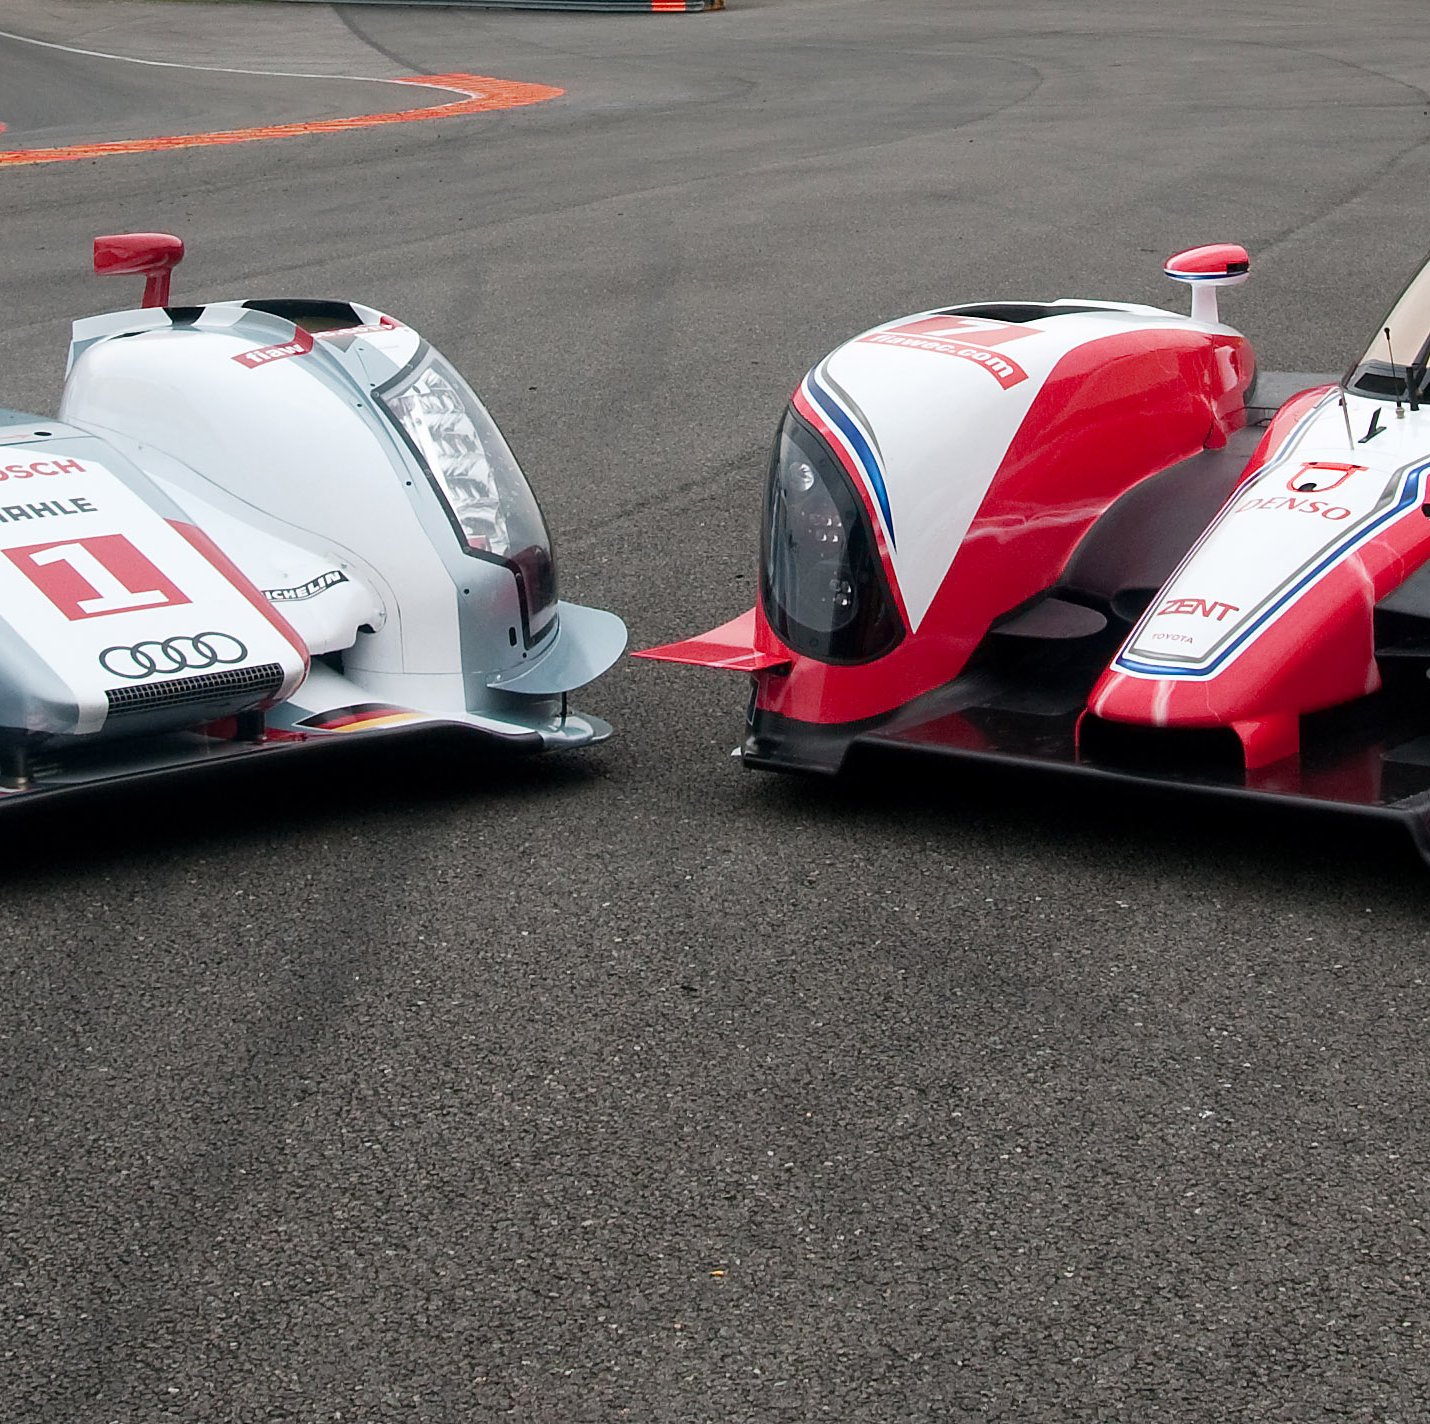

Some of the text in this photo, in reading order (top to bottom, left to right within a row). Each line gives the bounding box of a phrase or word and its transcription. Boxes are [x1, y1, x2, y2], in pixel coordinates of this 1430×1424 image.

[922, 319, 1010, 336] 7
[870, 334, 1014, 379] fiawec.com
[1235, 497, 1351, 520] DENSO
[28, 542, 170, 614] 1
[264, 571, 341, 600] ICHELIN
[1157, 598, 1240, 621] ZENT
[1152, 633, 1194, 645] TOYOTA
